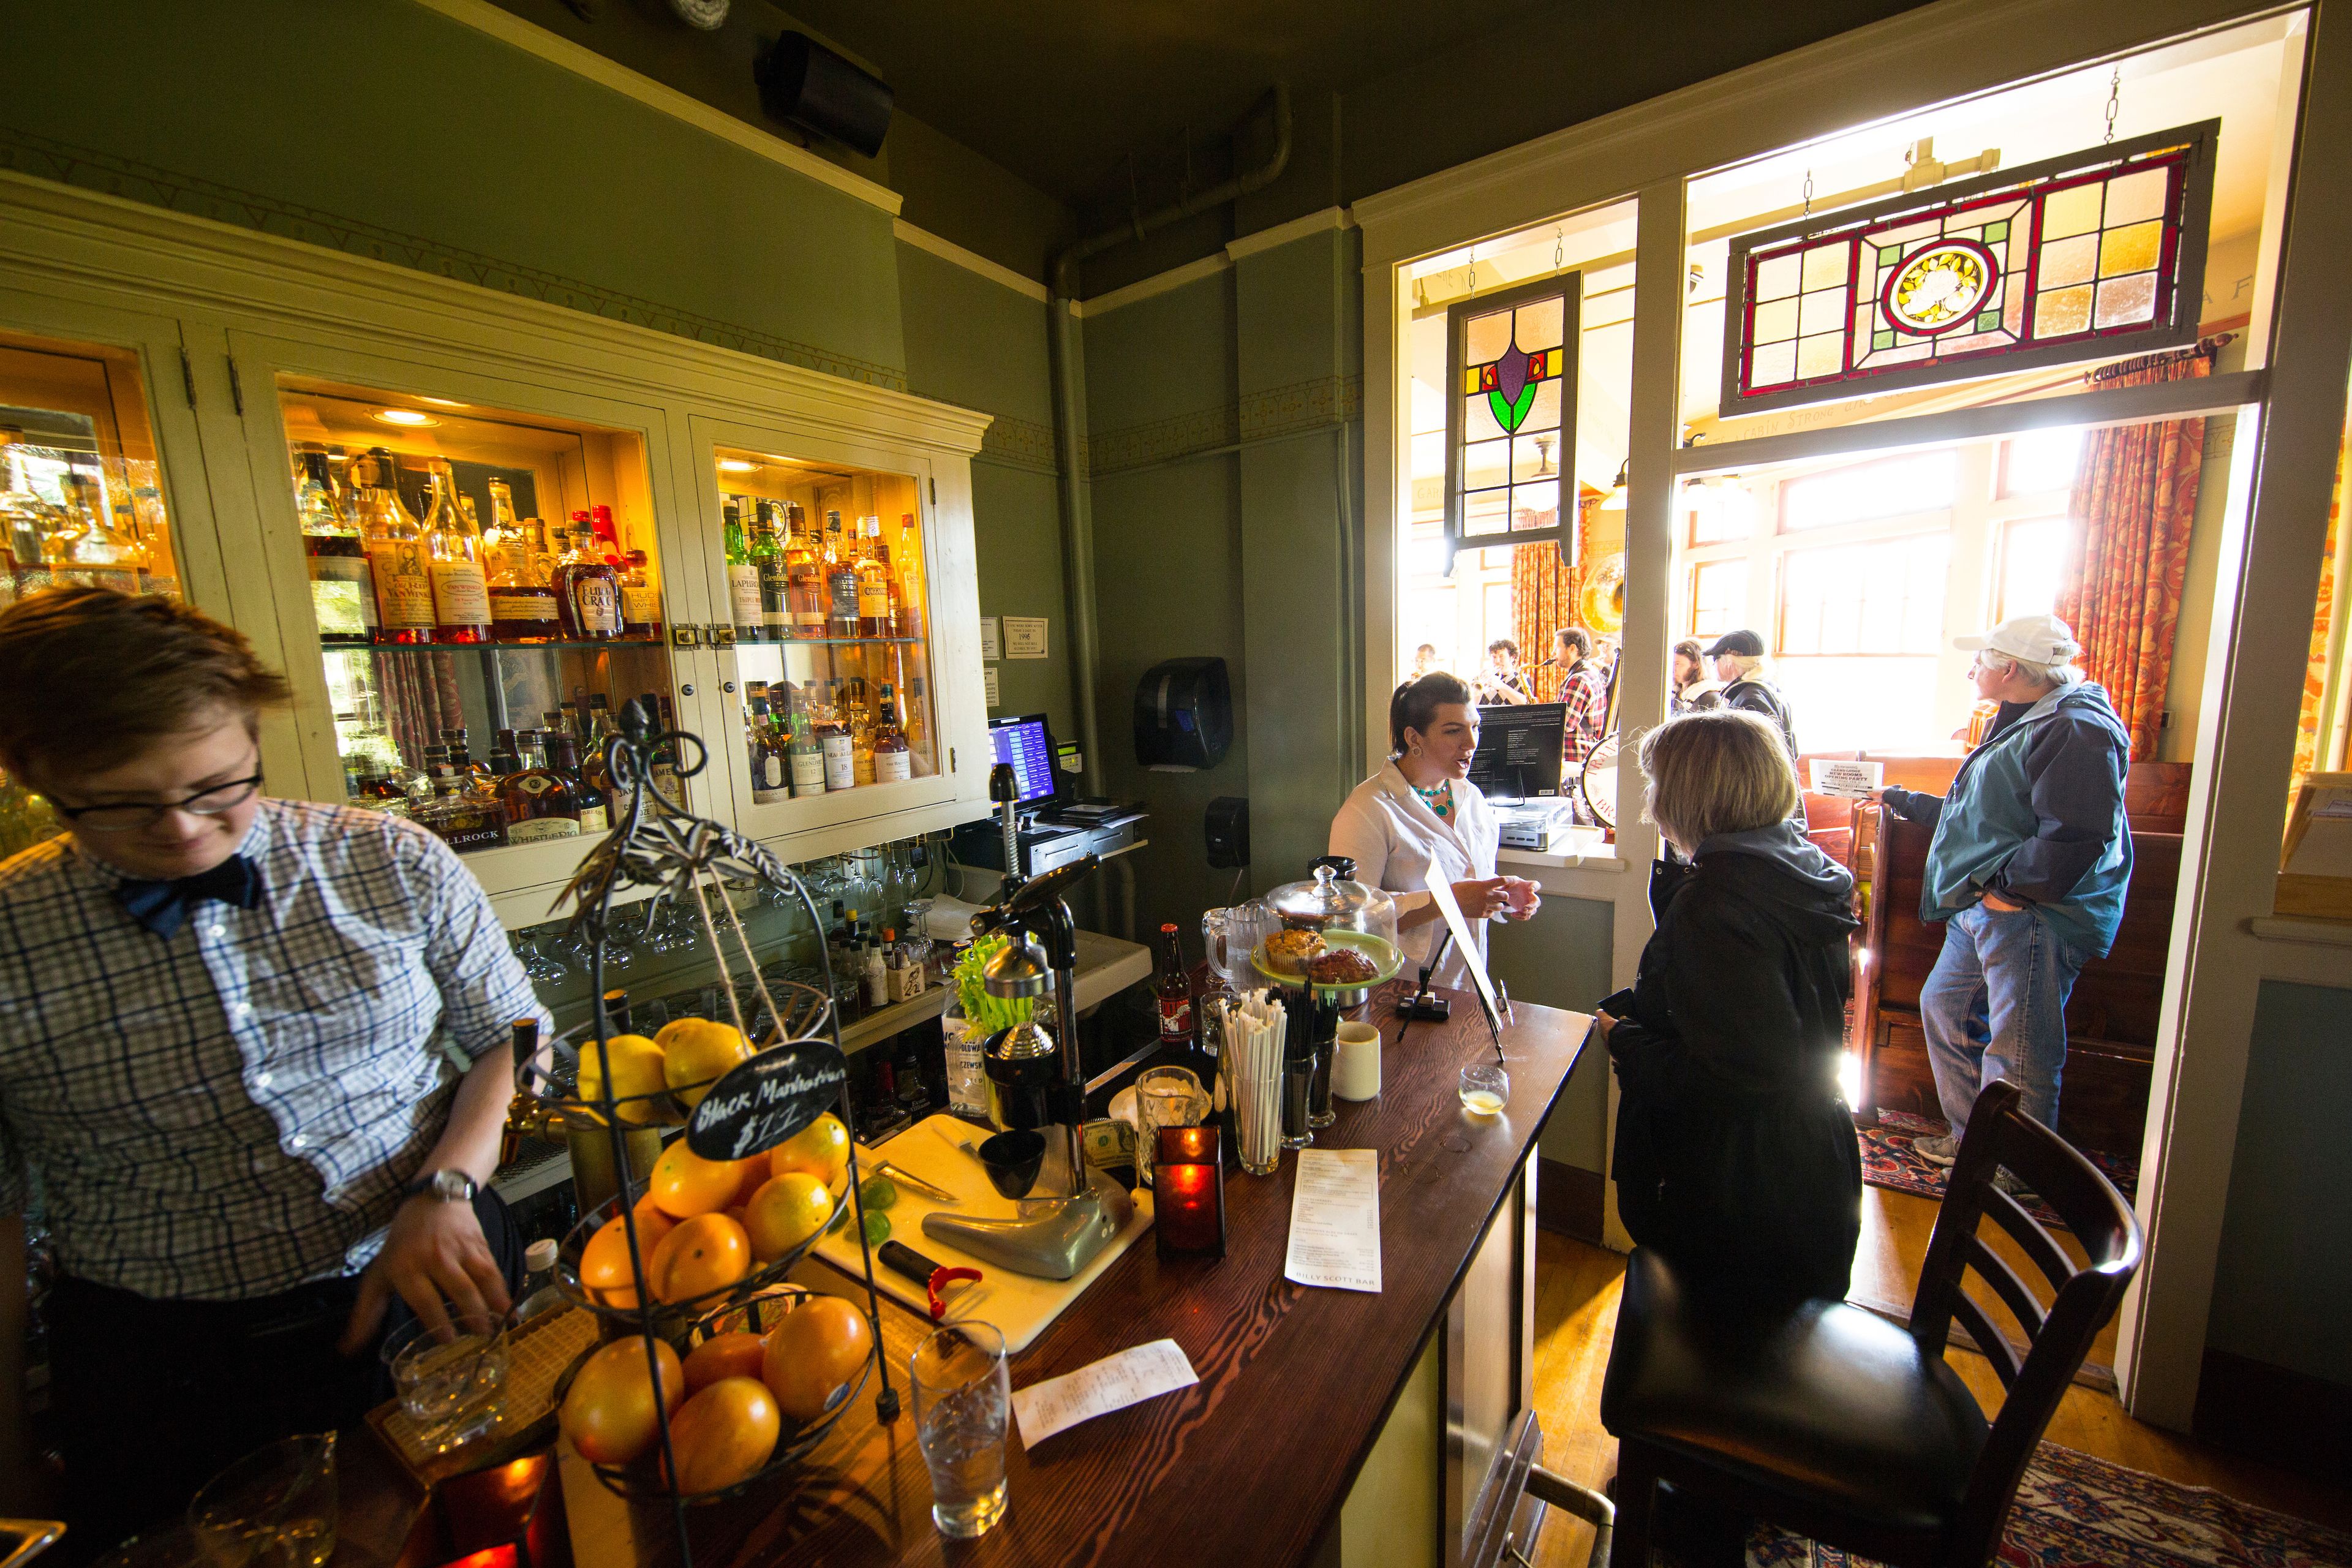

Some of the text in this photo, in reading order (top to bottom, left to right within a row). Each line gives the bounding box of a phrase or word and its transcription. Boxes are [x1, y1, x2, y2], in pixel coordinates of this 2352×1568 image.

[582, 594, 611, 608] CRAIG
[696, 1091, 752, 1133] Black
[1296, 1272, 1322, 1281] BILLY
[1324, 1273, 1352, 1284] SCOTT
